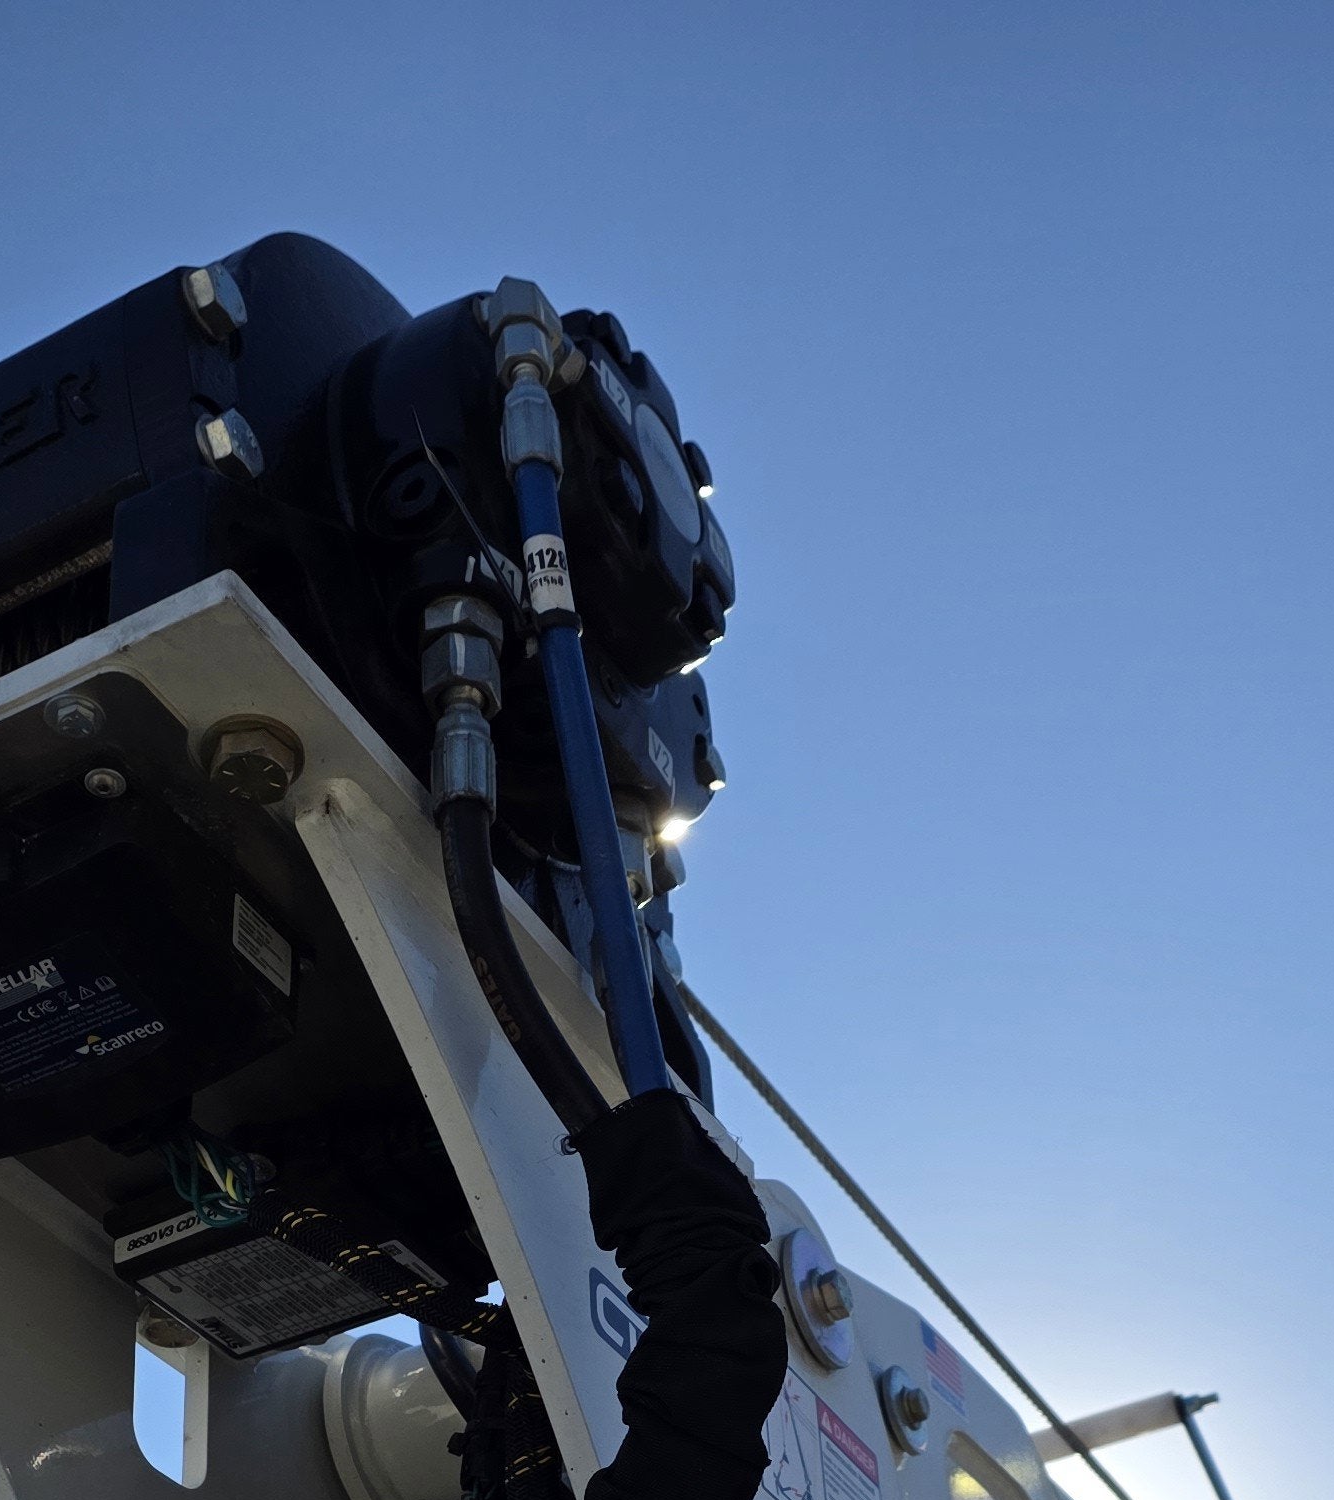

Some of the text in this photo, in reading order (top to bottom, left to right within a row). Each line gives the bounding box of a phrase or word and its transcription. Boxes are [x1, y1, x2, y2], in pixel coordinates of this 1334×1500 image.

[92, 1020, 165, 1056] scanreco
[127, 1231, 157, 1252] 8630
[158, 1224, 174, 1240] V3
